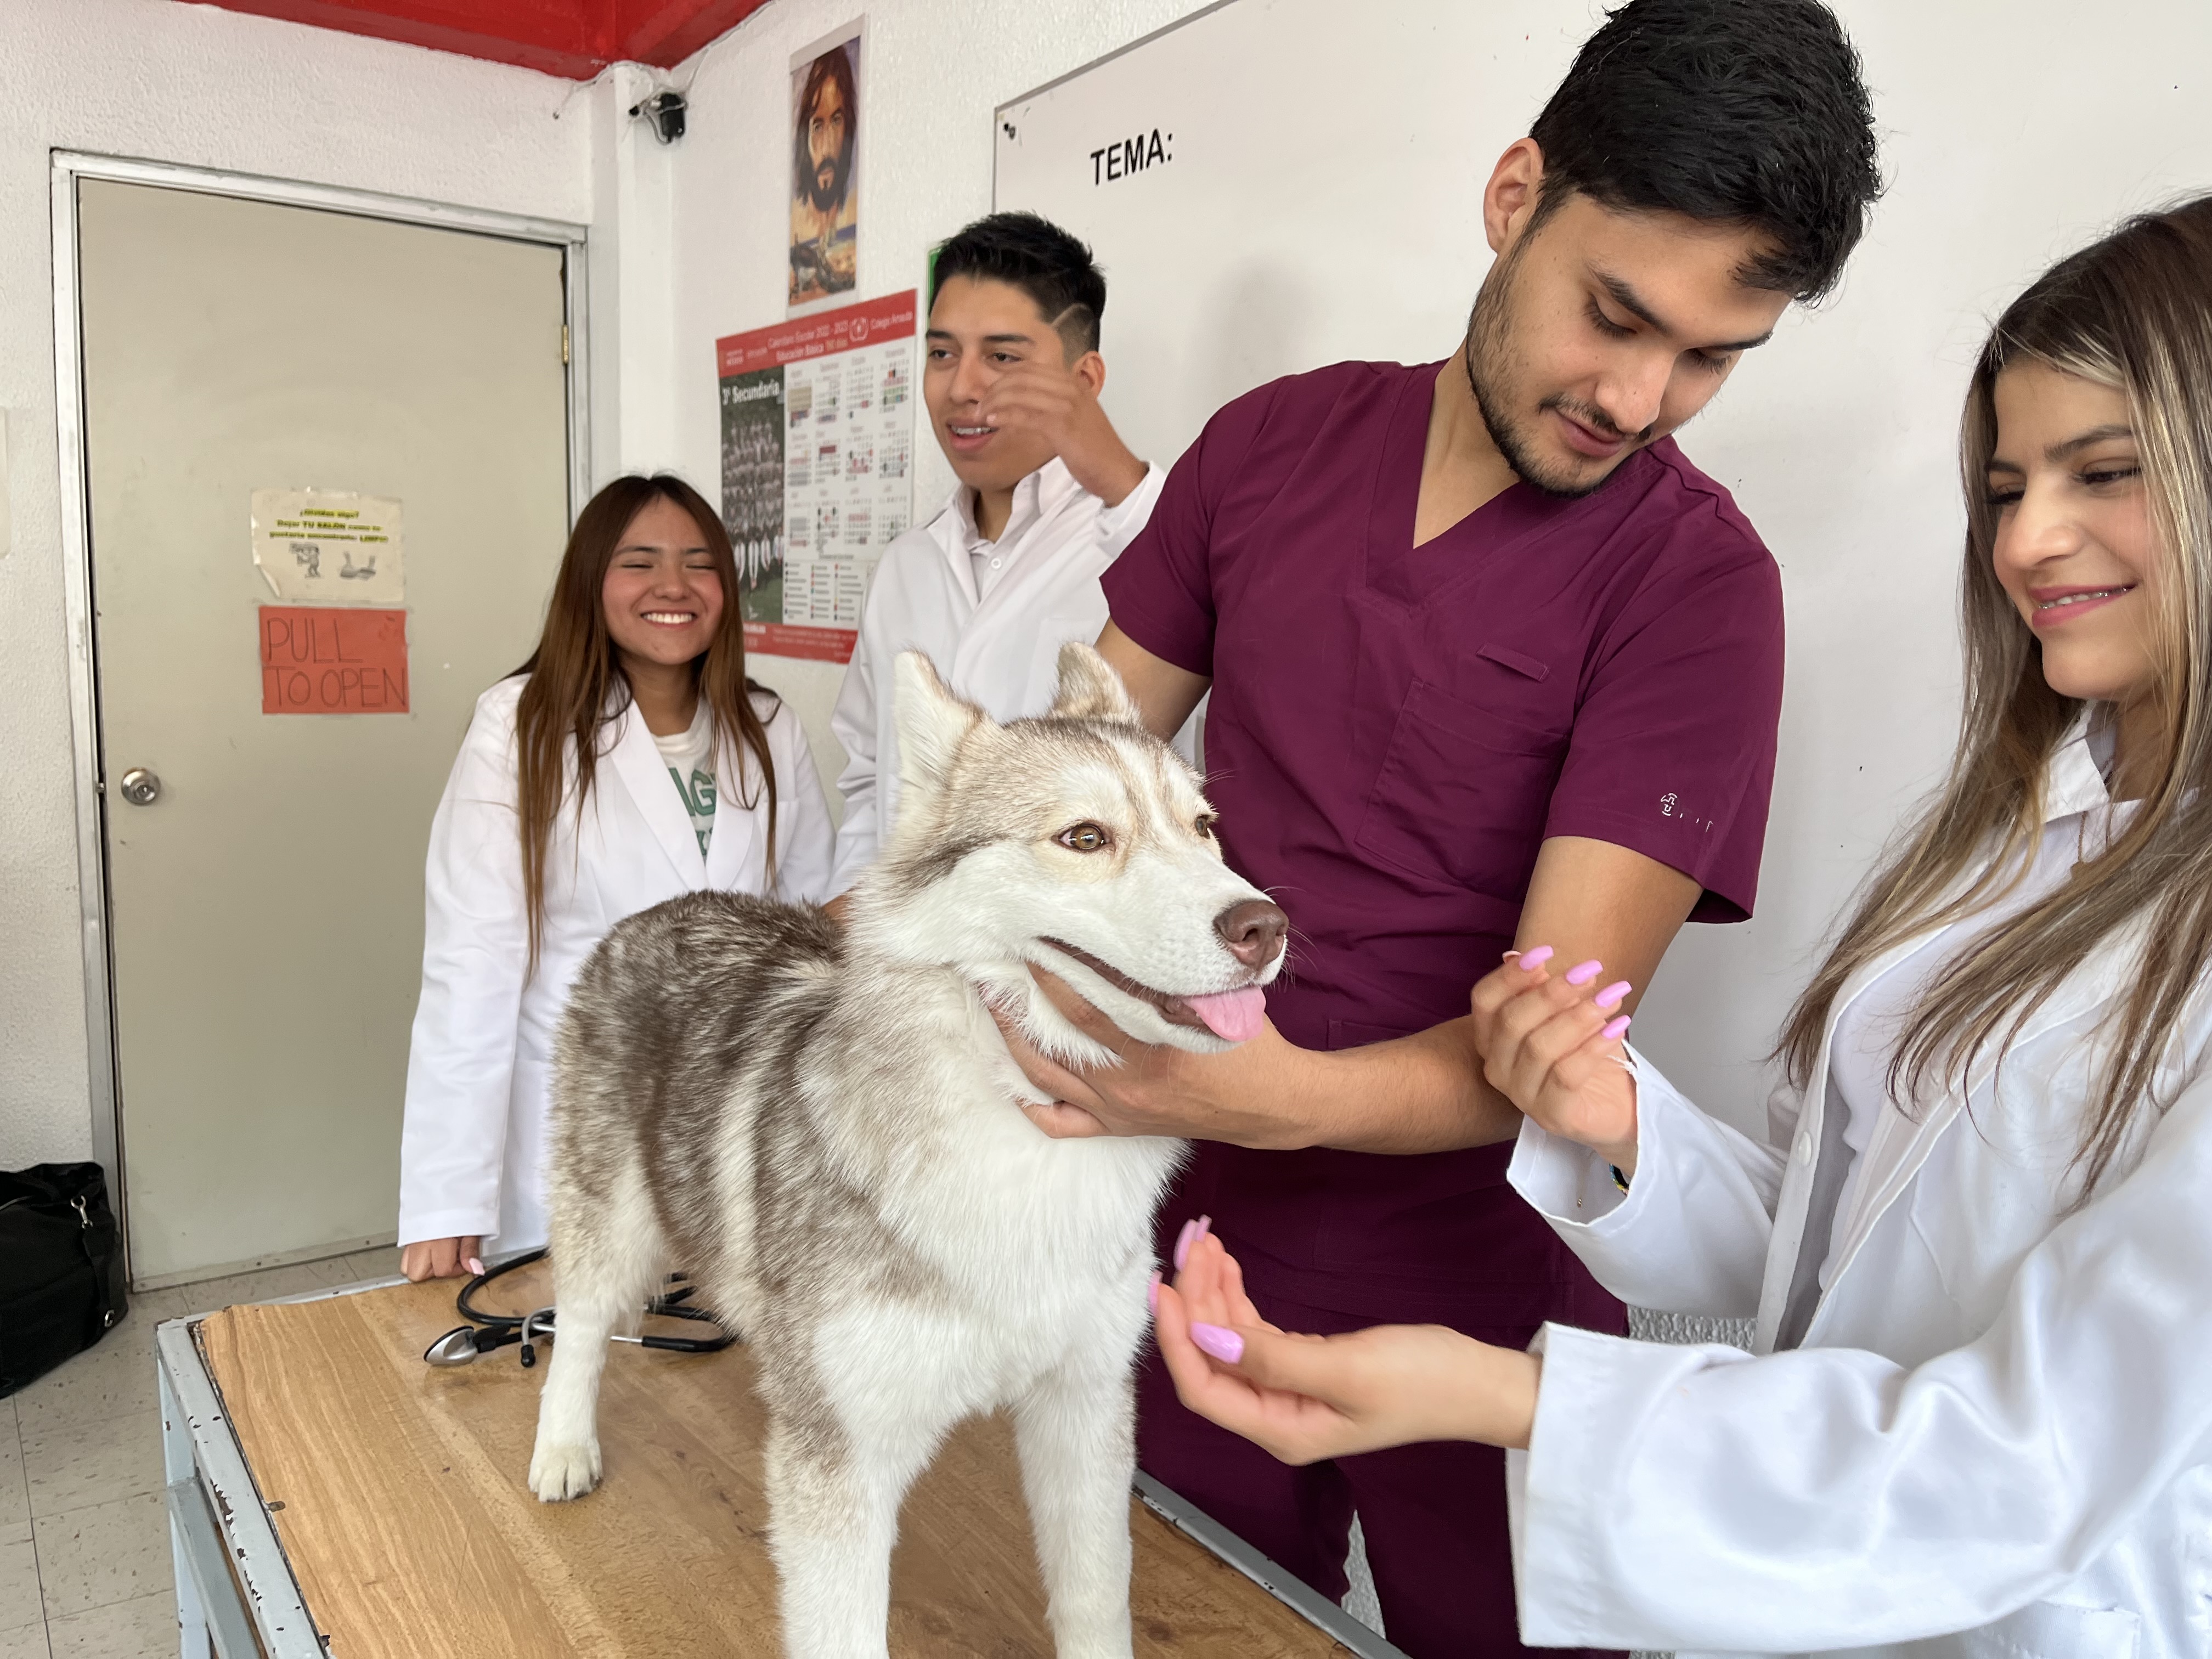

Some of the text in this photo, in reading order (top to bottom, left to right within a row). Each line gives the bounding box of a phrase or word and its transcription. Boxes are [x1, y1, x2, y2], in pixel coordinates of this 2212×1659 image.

[1090, 128, 1172, 185] TEMA:
[732, 379, 780, 404] Secundaria
[267, 617, 363, 664] PULL
[263, 665, 407, 708] TO OPEN
